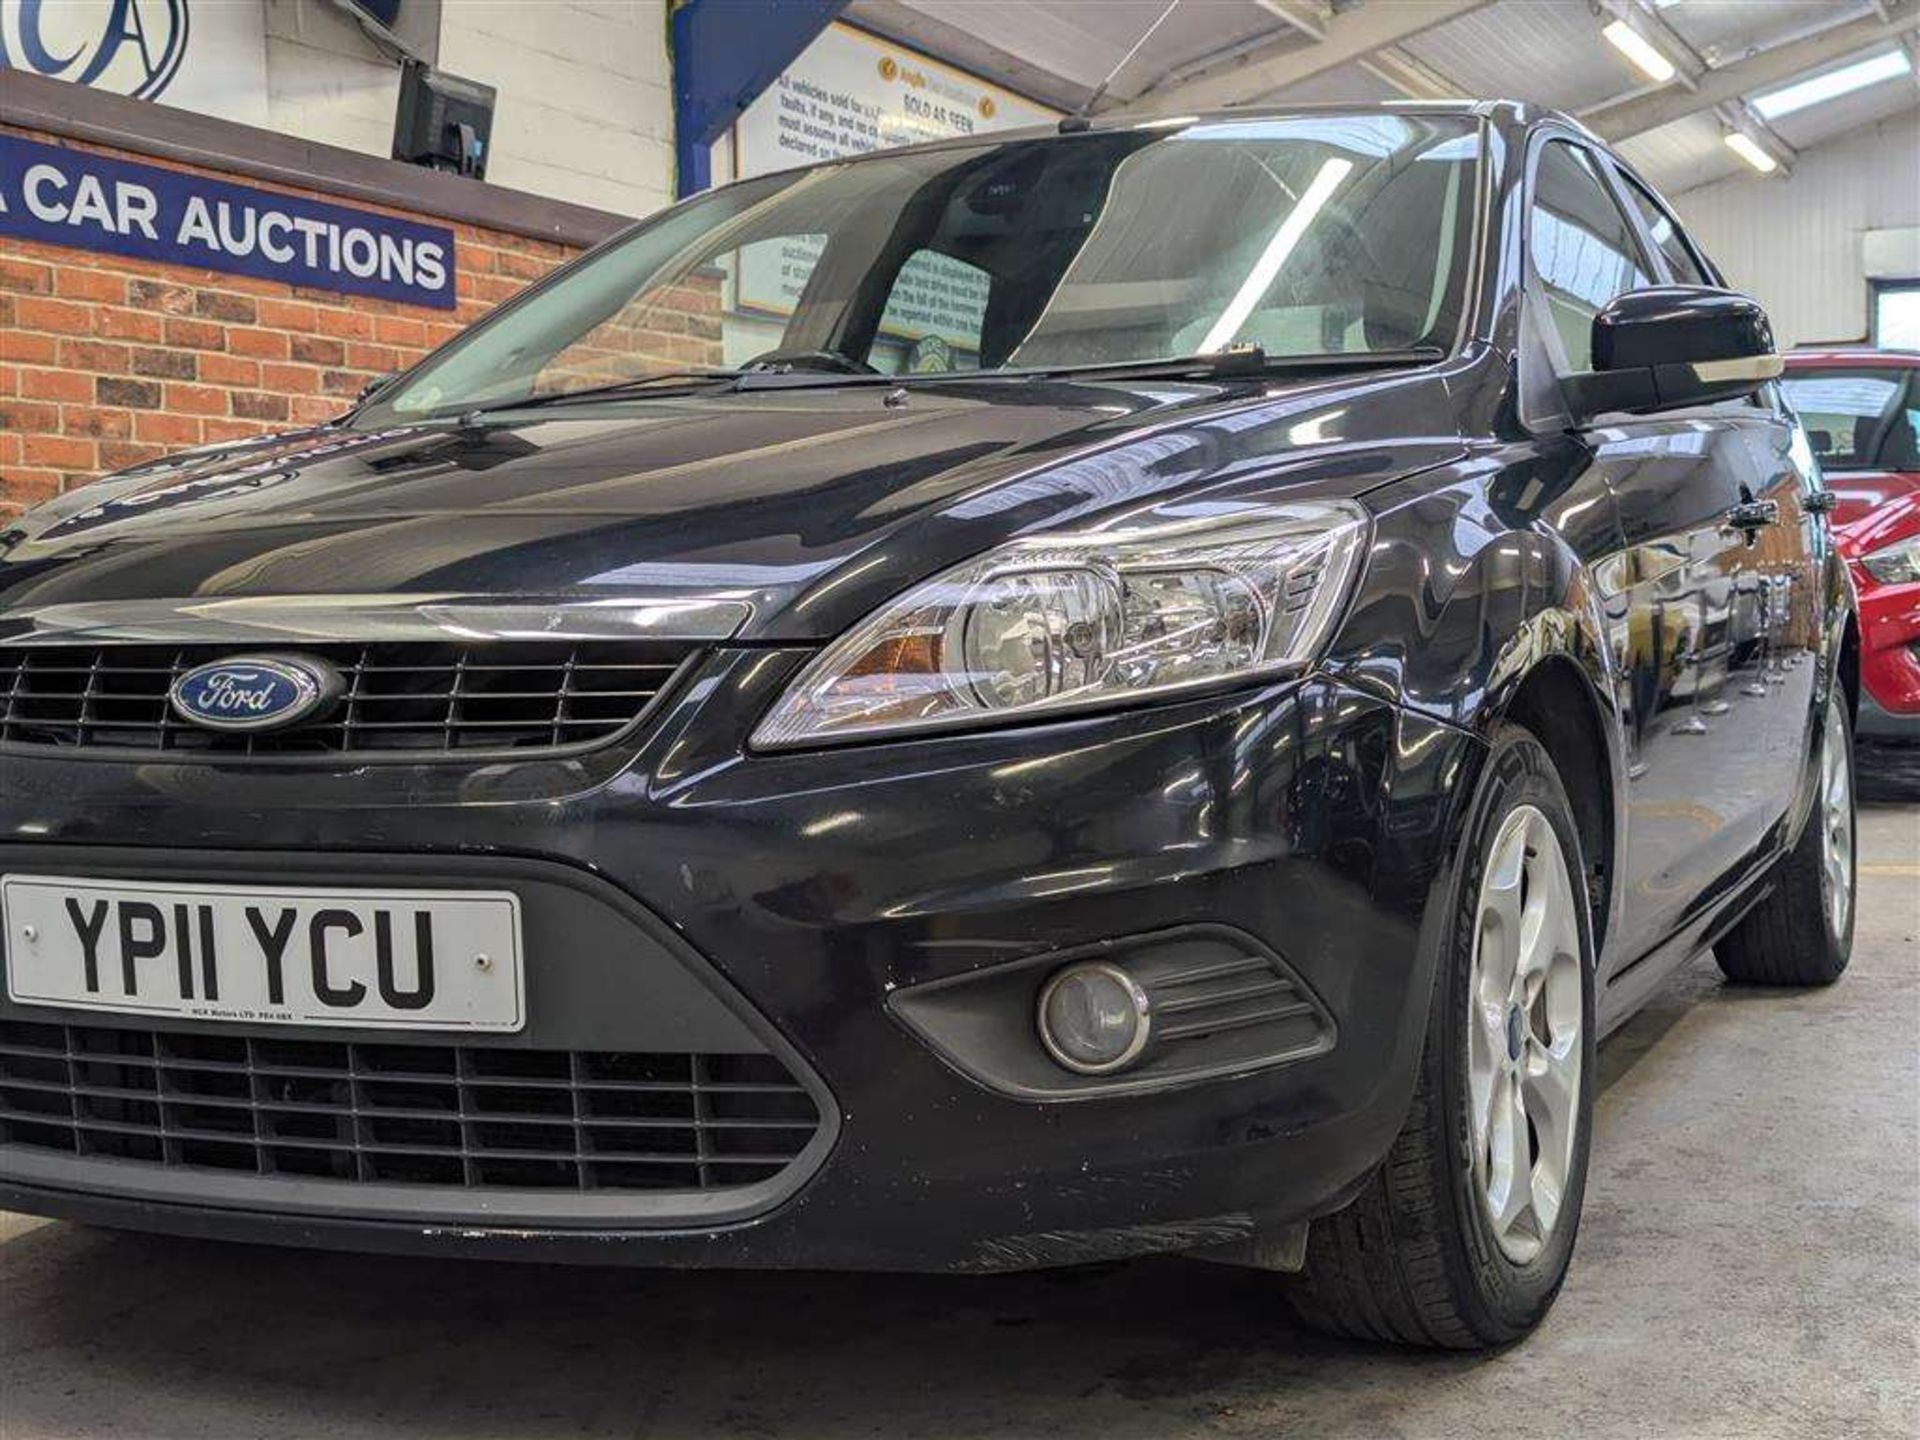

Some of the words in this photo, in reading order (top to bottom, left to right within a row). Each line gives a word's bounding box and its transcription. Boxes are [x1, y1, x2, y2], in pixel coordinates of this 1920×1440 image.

[903, 93, 931, 119] SOLD
[933, 105, 946, 122] AS
[23, 164, 158, 241] CAR
[177, 196, 446, 290] AUCTIONS
[198, 672, 276, 710] Ford
[245, 905, 435, 1010] YCU
